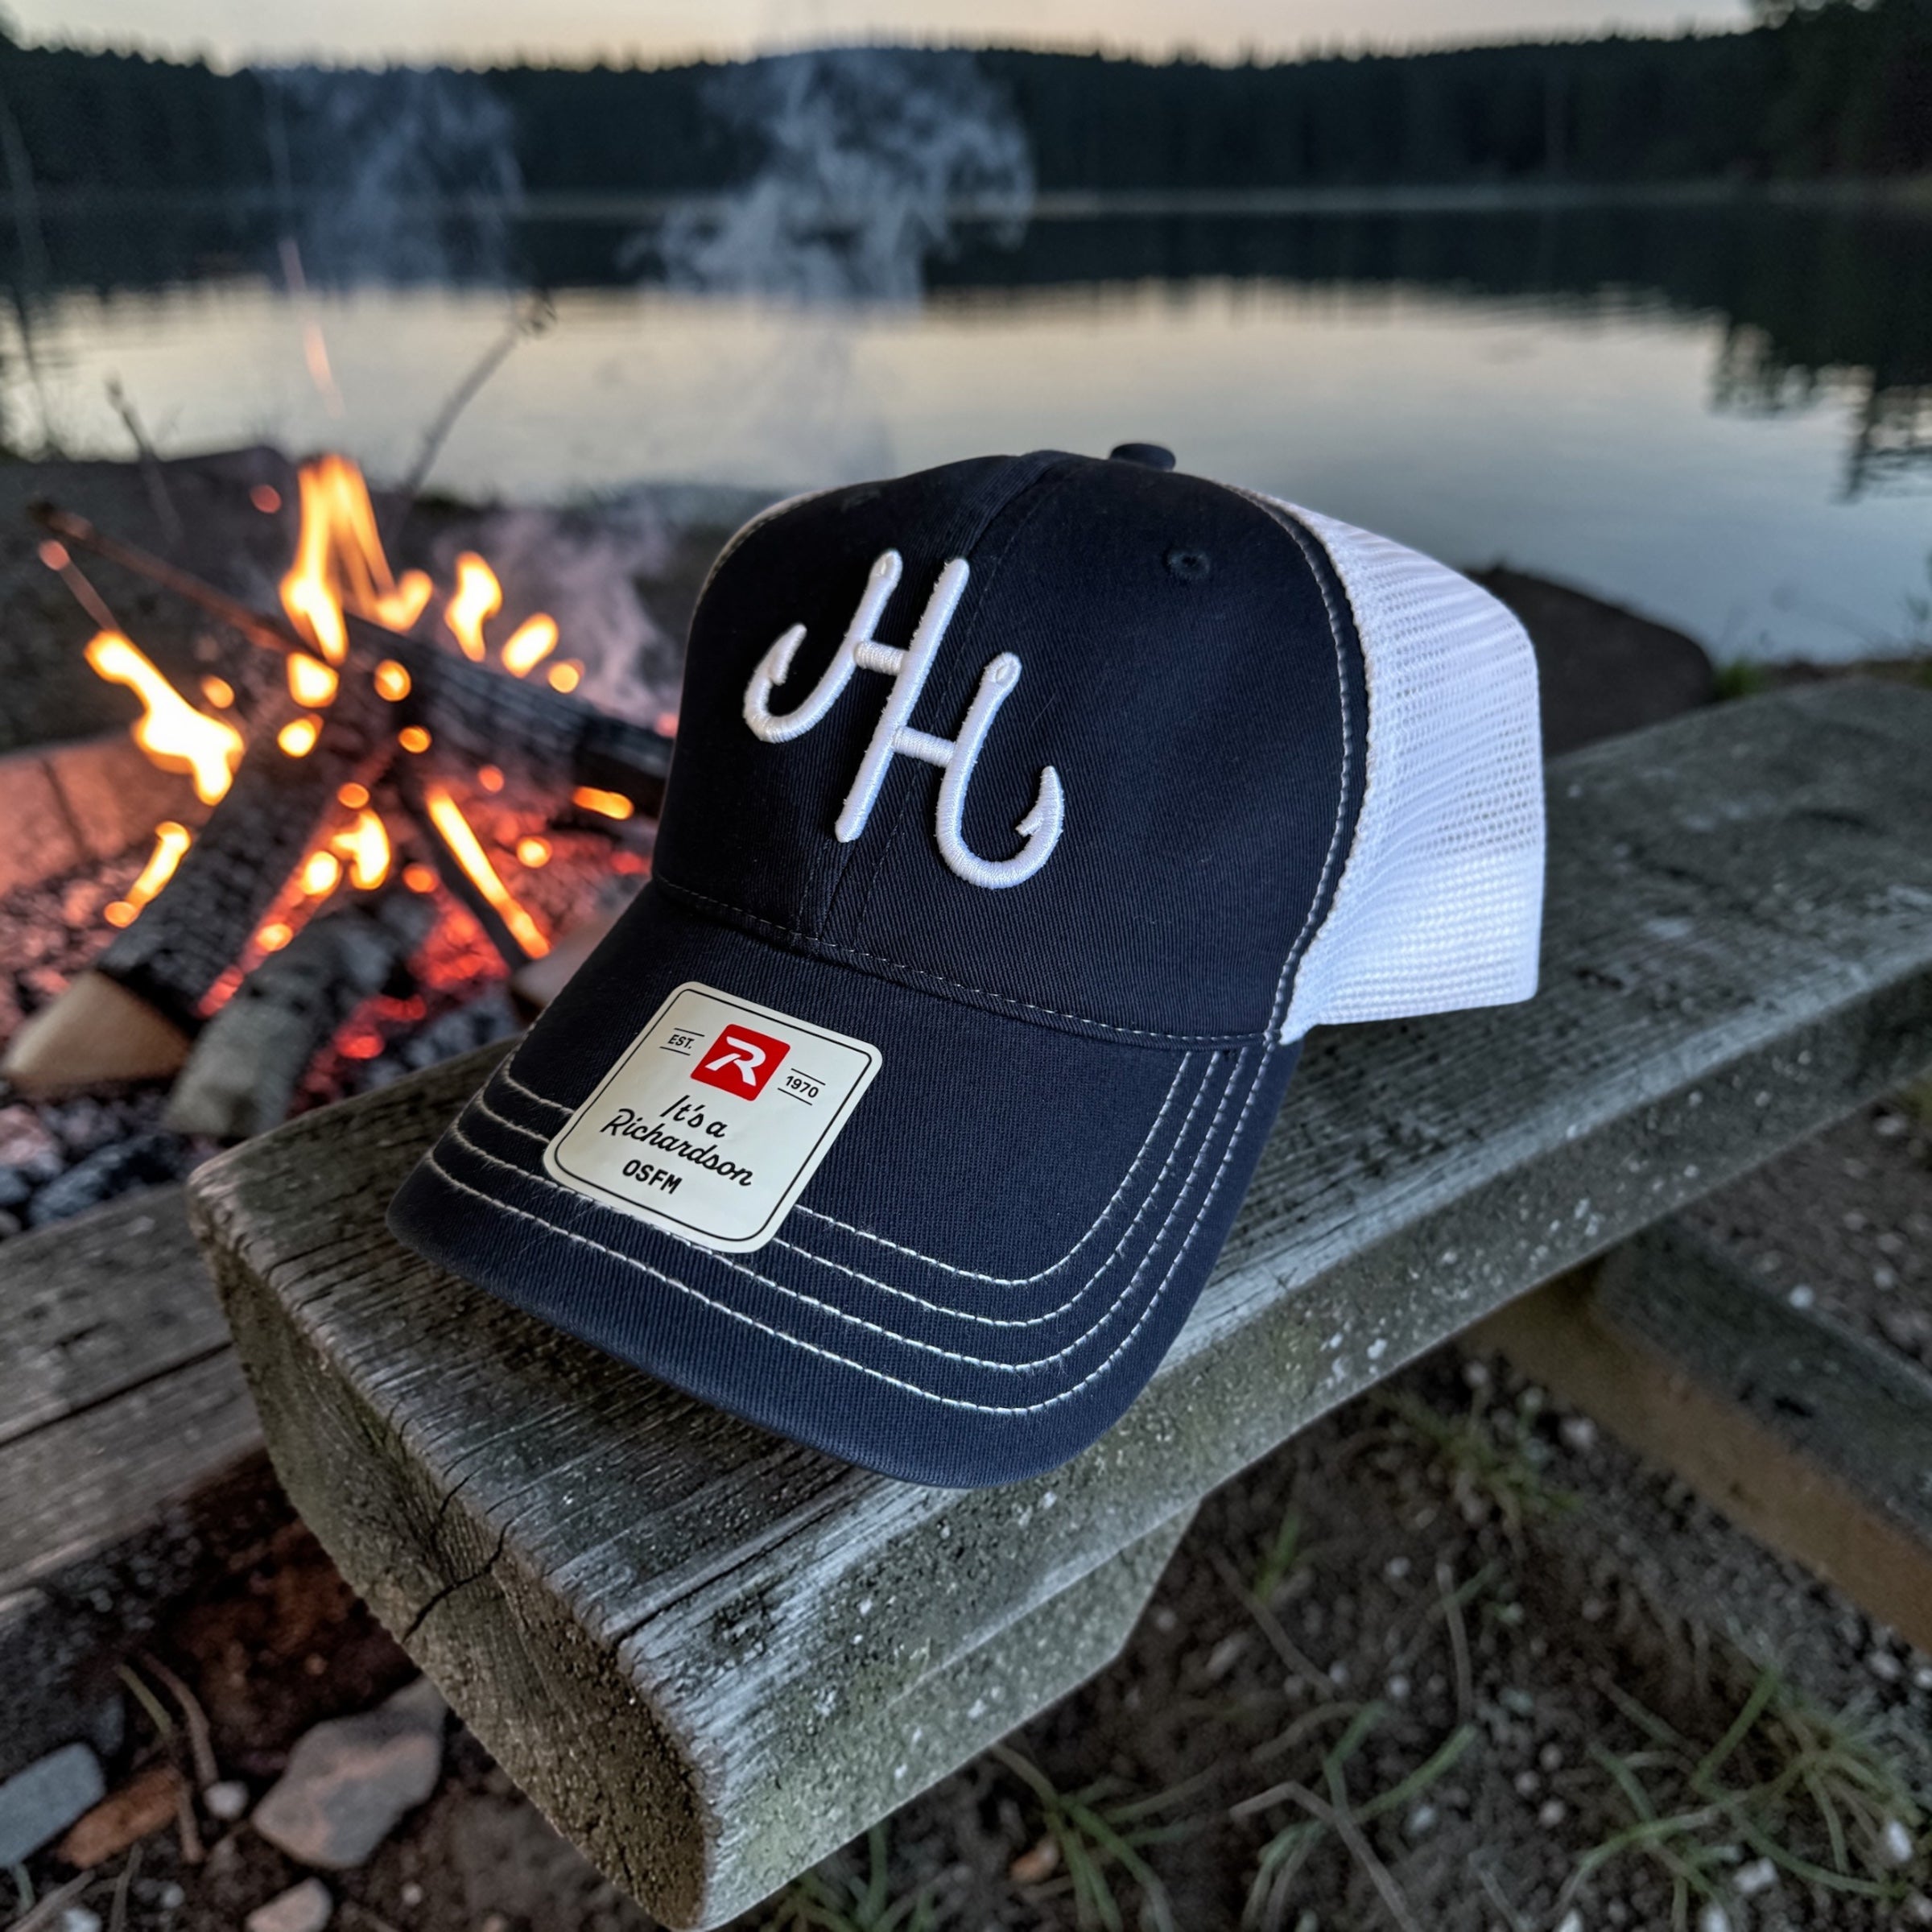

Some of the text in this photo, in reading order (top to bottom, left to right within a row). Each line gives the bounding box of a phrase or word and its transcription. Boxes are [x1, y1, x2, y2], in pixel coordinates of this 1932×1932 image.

[667, 1034, 693, 1049] EST.
[704, 1035, 767, 1087] R
[785, 1075, 819, 1099] 1970
[659, 1095, 728, 1139] It's a
[600, 1108, 753, 1187] Richardson
[622, 1159, 683, 1195] OSFM
